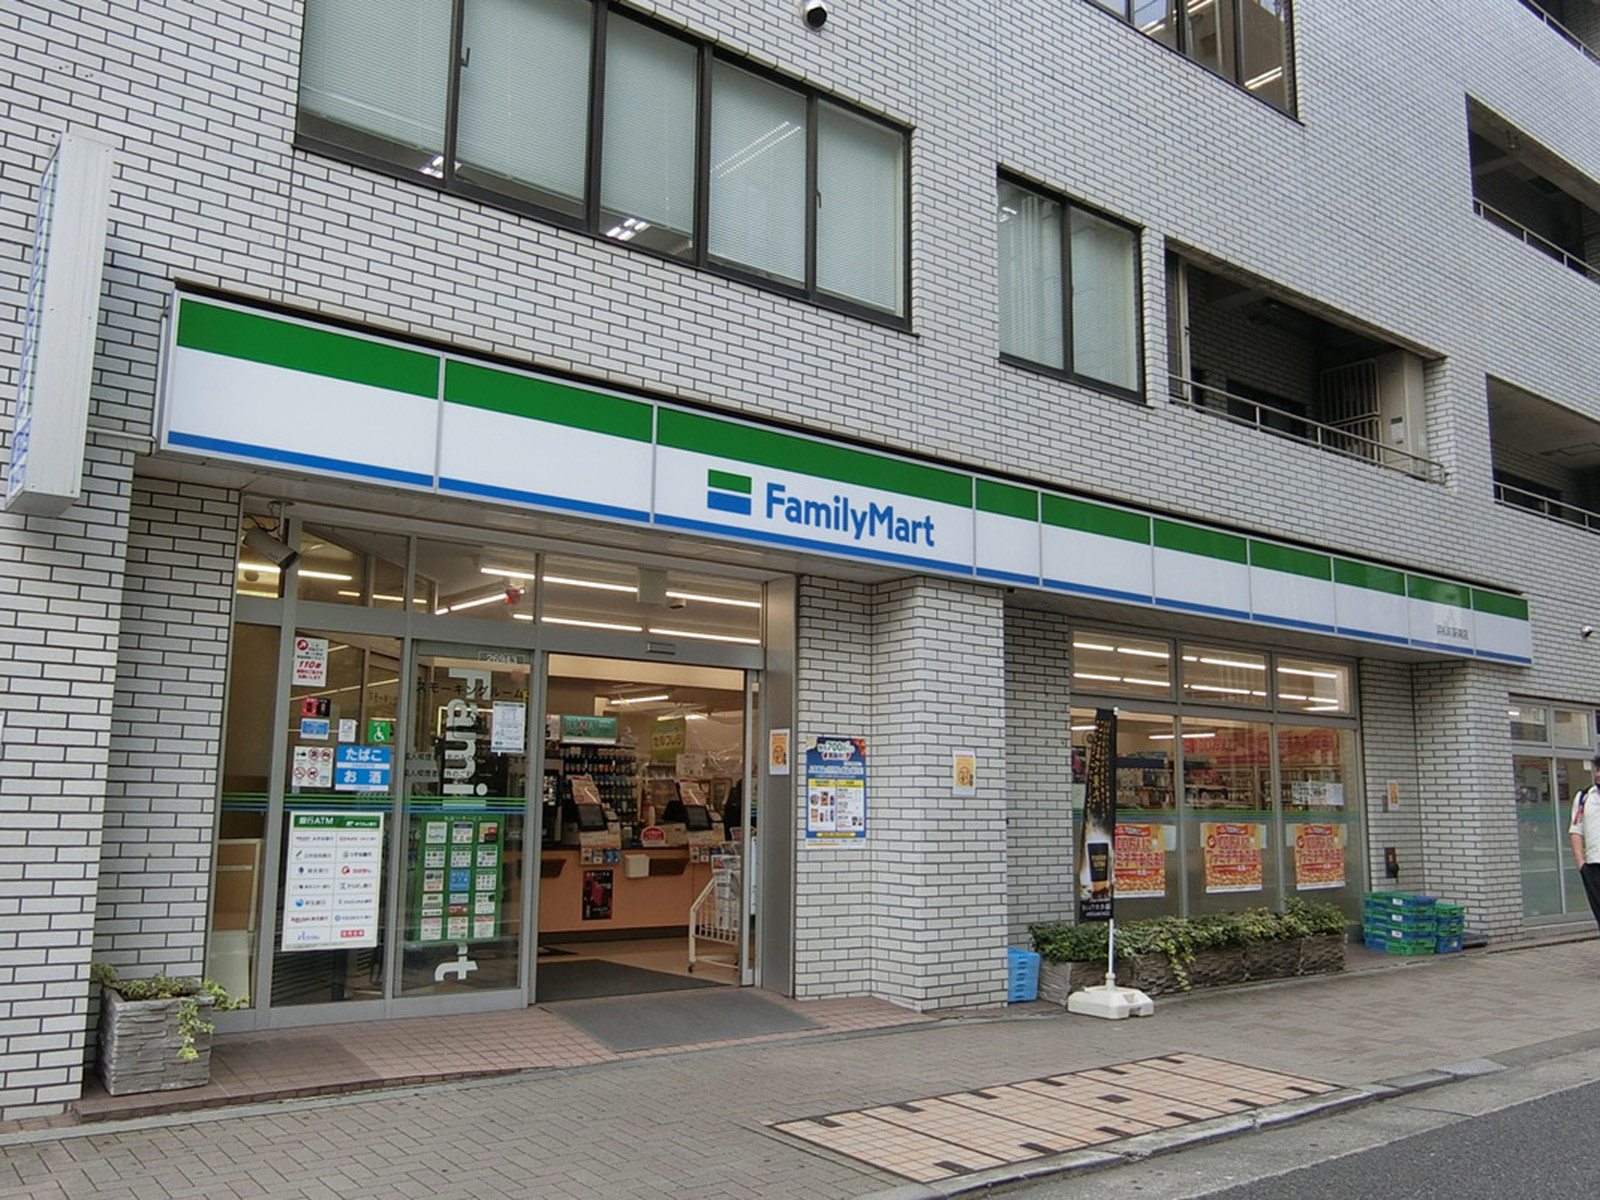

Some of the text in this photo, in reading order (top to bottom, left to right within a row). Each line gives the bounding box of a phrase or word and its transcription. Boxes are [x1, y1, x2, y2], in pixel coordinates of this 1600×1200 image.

[766, 482, 935, 547] FamilyMart
[345, 748, 382, 761] たばこ
[344, 770, 382, 784] お酒
[299, 816, 334, 825] 銀行ATM
